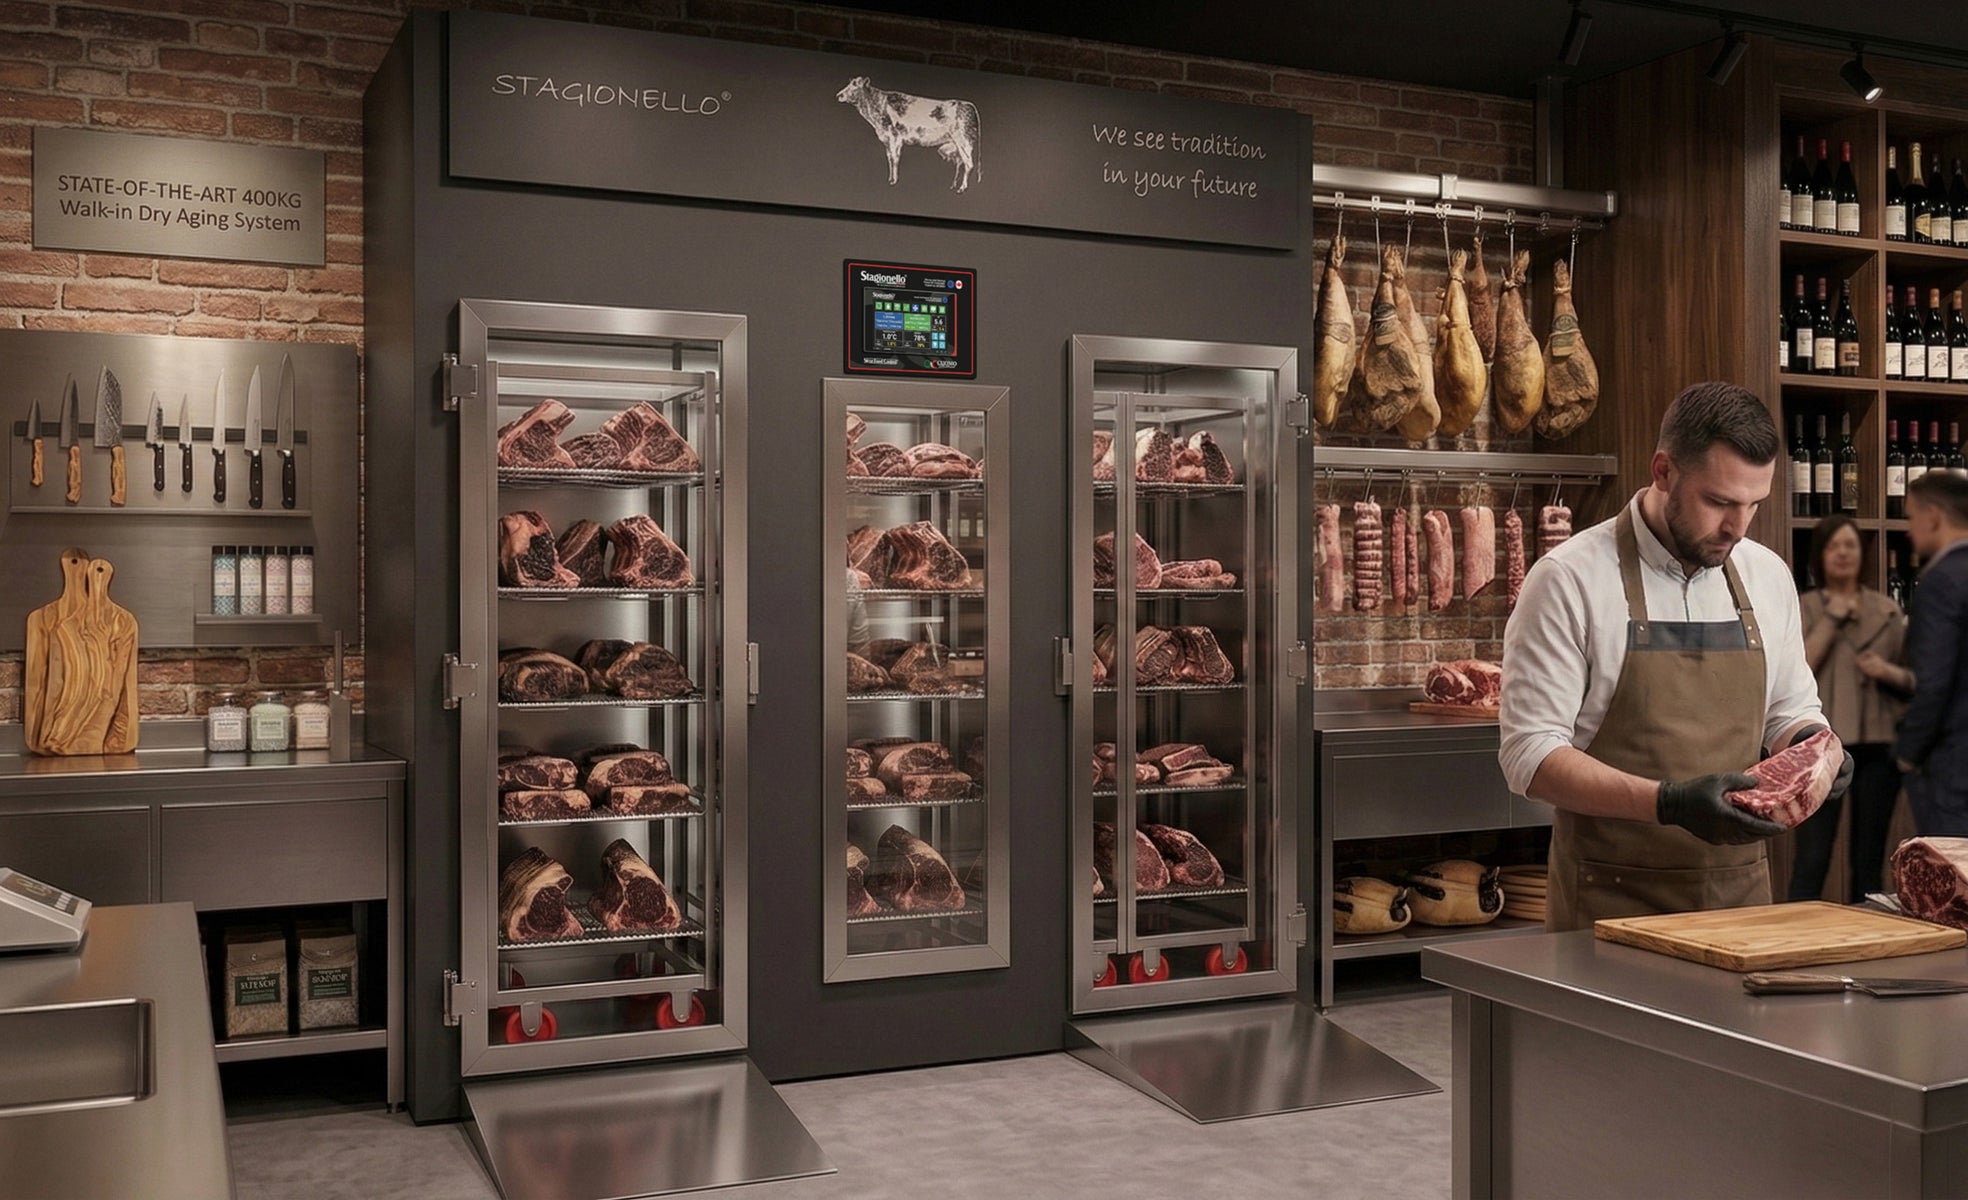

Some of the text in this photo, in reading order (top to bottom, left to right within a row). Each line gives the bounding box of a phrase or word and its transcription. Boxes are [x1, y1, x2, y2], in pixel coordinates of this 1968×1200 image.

[1092, 124, 1266, 160] We see tradition
[58, 175, 302, 208] STATE-OF-THE-ART 400KG
[1103, 161, 1257, 198] in your future
[59, 199, 301, 232] Walk-in Dry Aging System
